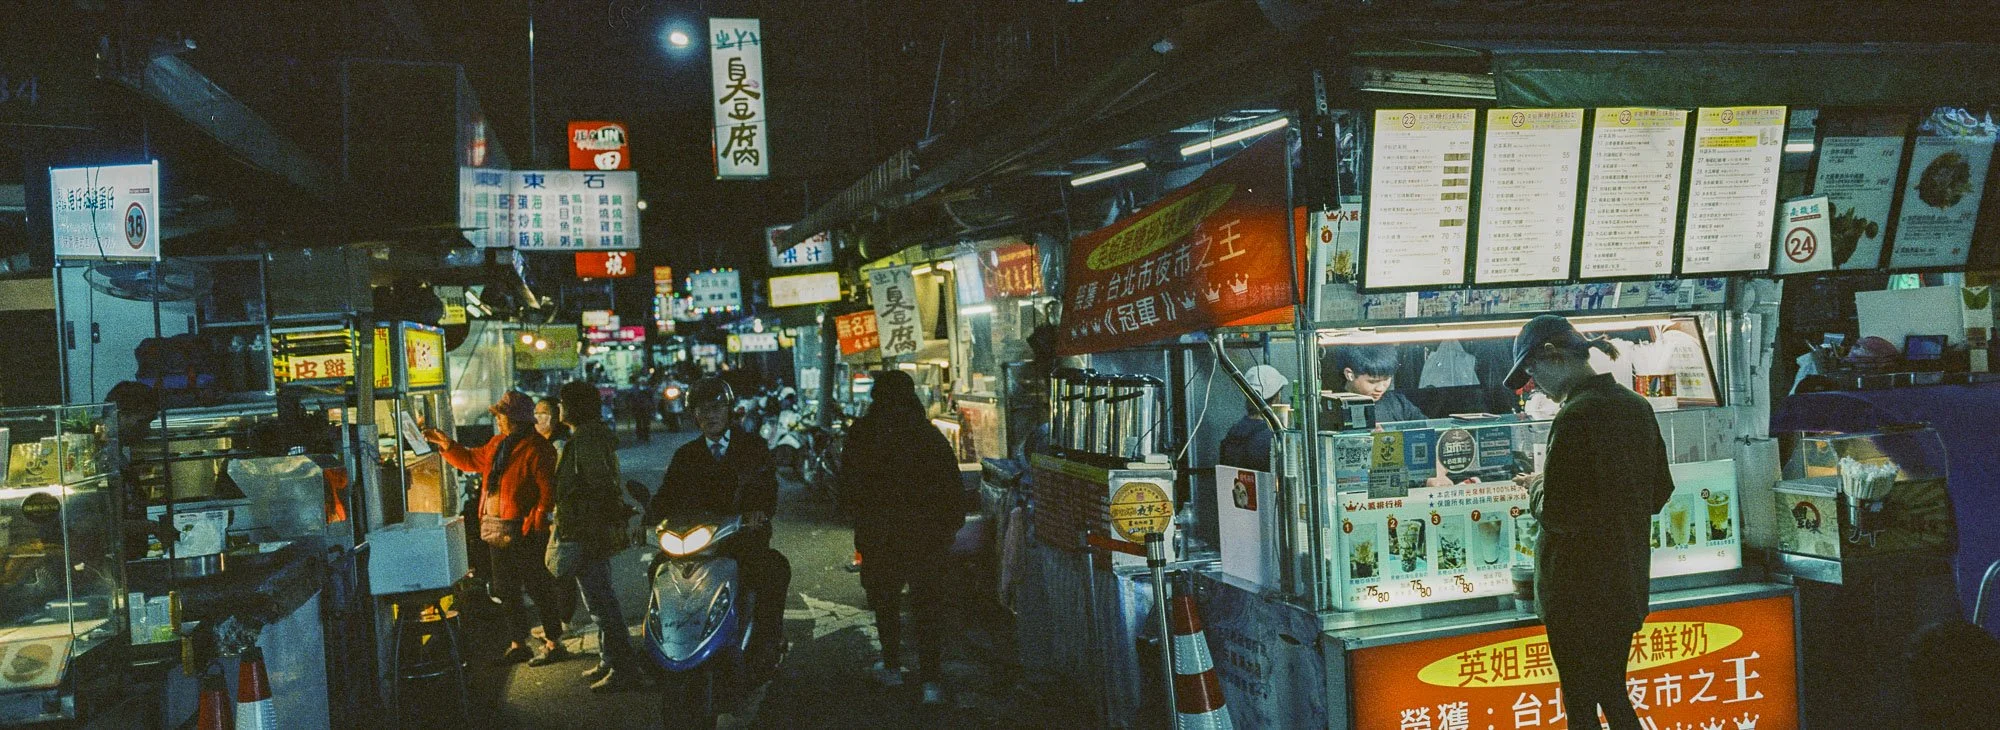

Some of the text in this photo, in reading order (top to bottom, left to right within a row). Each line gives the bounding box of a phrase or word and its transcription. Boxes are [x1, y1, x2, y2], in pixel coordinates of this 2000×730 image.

[719, 57, 762, 167] 臭豆腐
[522, 173, 605, 189] 東 石
[1790, 235, 1813, 256] 24
[881, 286, 916, 354] 臭豆腐
[1358, 499, 1403, 511] 人氣排行榜
[1410, 579, 1422, 591] 75
[1453, 574, 1465, 586] 75
[1366, 585, 1378, 597] 75
[1420, 586, 1432, 598] 80
[1462, 582, 1474, 594] 80
[1377, 591, 1390, 603] 80
[1456, 622, 1708, 687] 英姐黑味鮮奶
[1400, 654, 1764, 730] 榮獲：台夜市之王
